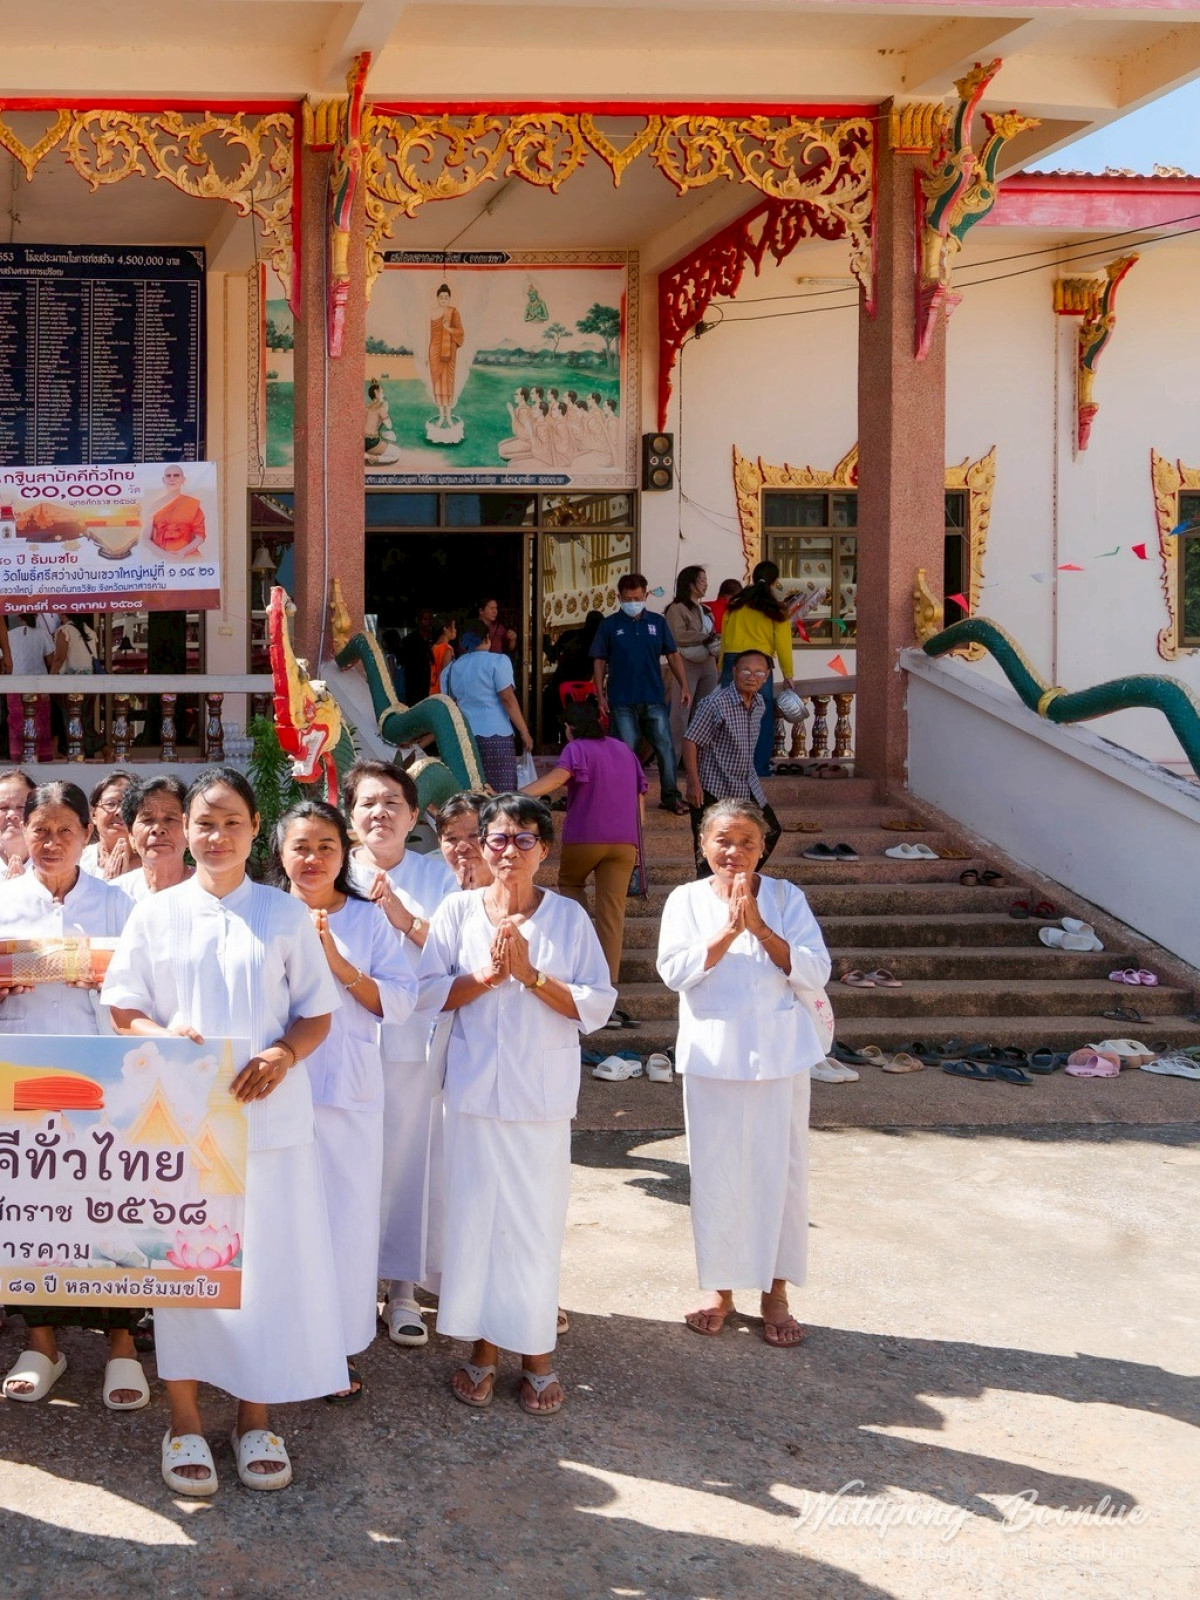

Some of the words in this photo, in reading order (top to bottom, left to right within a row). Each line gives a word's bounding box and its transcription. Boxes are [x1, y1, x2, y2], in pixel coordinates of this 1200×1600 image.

[4, 466, 135, 486] กฐินสามัคคีทั่วไทย
[20, 484, 122, 500] ๓๐,๐๐๐
[16, 554, 26, 565] ปี
[31, 553, 79, 565] ธัมมชโย
[70, 600, 106, 611] ตุลาคม
[85, 1193, 208, 1225] ๒๕๖๘
[8, 1281, 36, 1294] ๘๑
[44, 1274, 57, 1295] ปี
[65, 1276, 219, 1297] หลวงพ่อธัมมชโย
